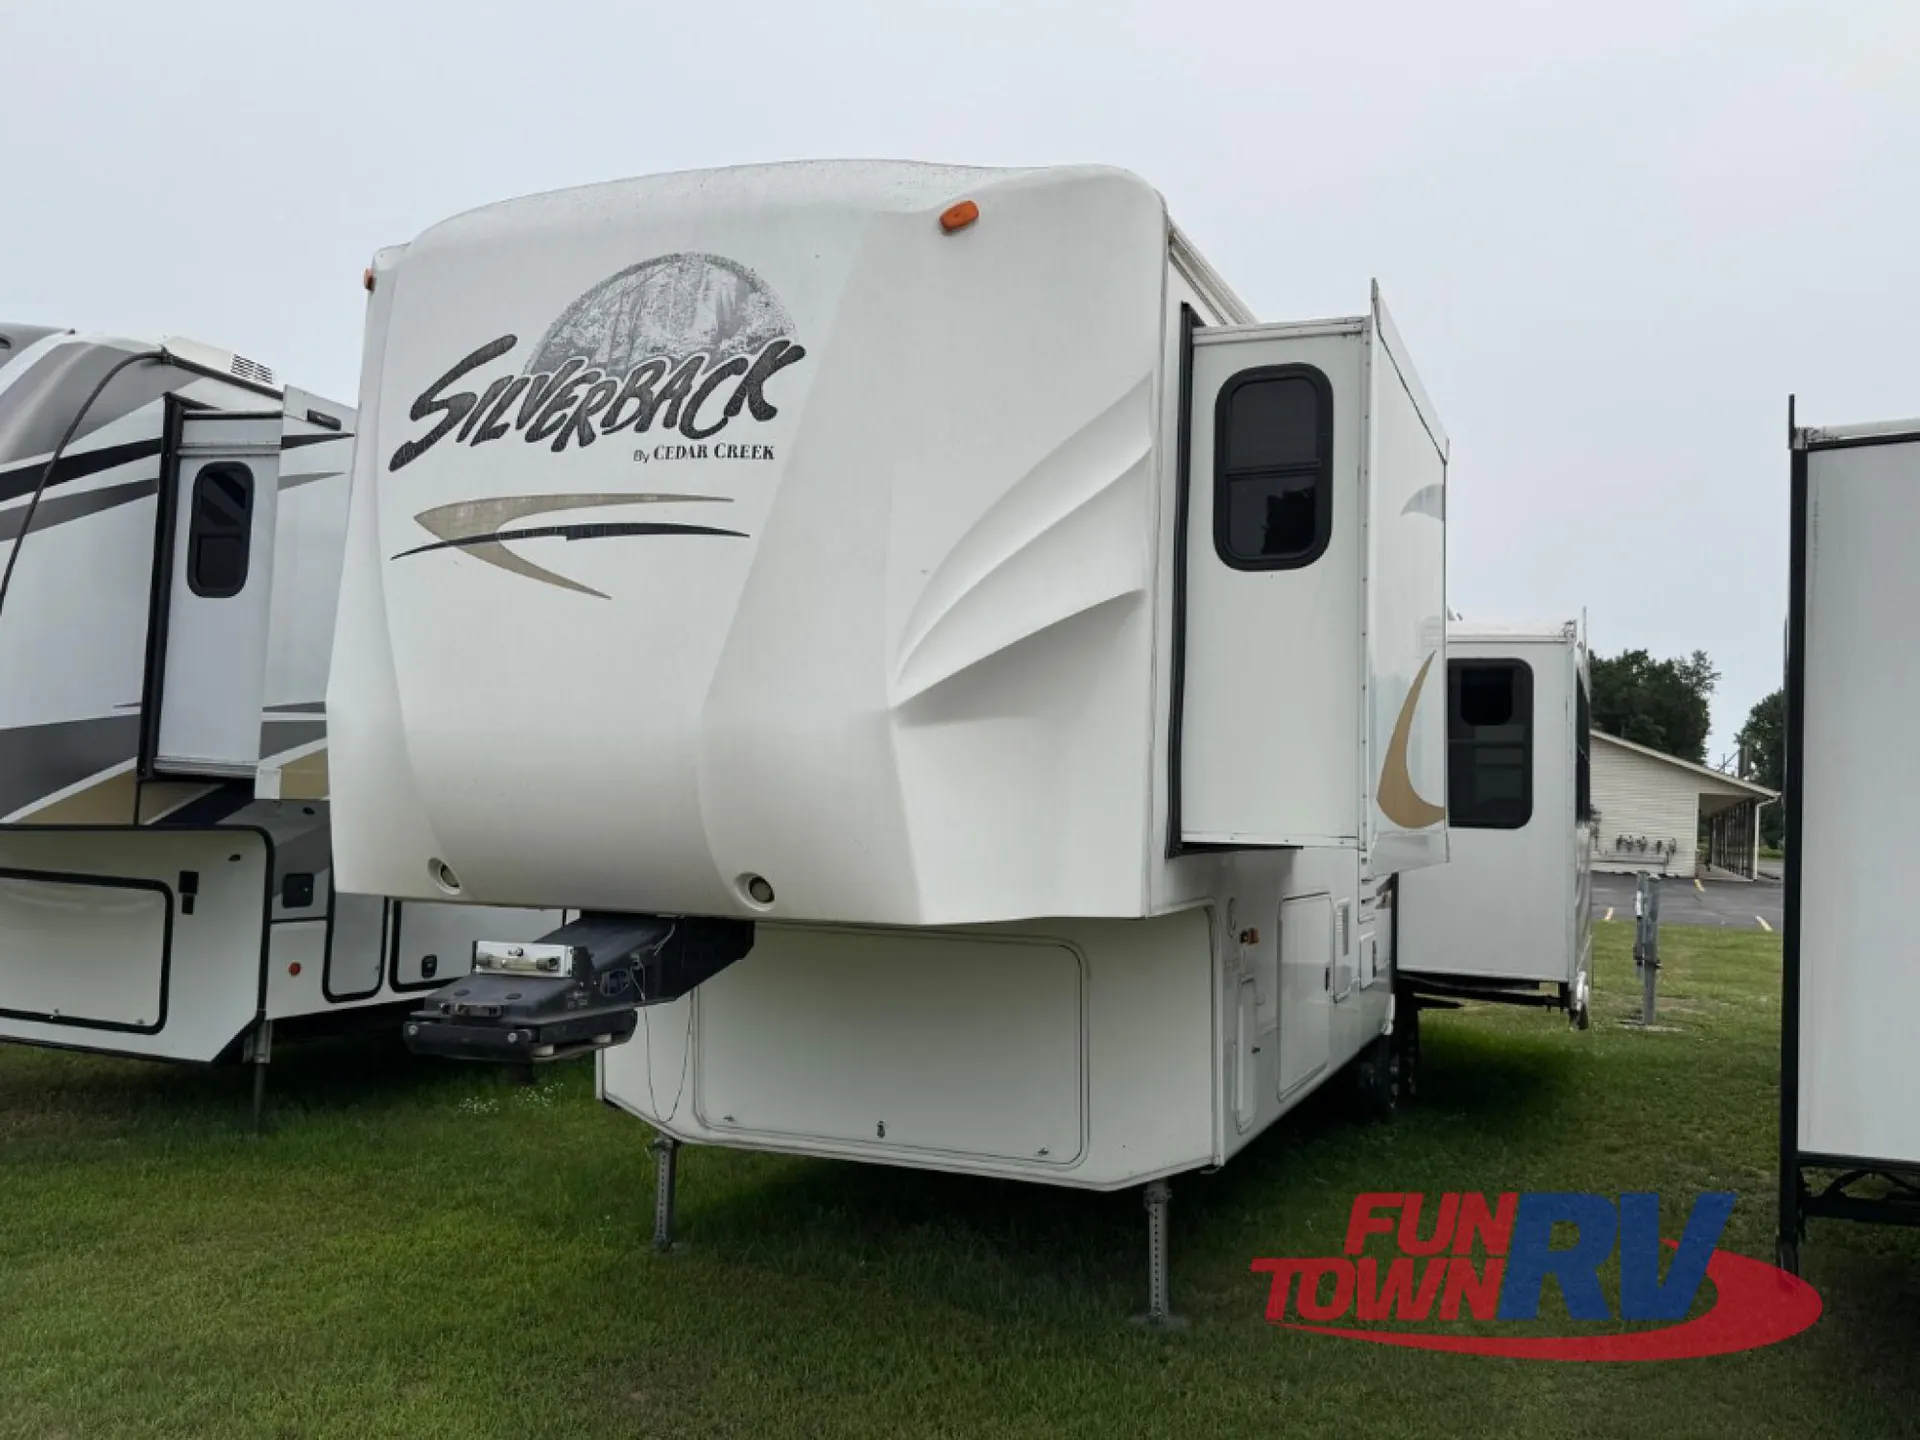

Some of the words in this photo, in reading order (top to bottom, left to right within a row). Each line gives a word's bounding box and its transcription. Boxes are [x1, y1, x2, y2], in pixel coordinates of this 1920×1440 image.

[388, 333, 806, 472] SILVERBACK
[633, 449, 650, 463] By
[653, 444, 708, 460] CEDAR
[713, 442, 775, 460] CREEK
